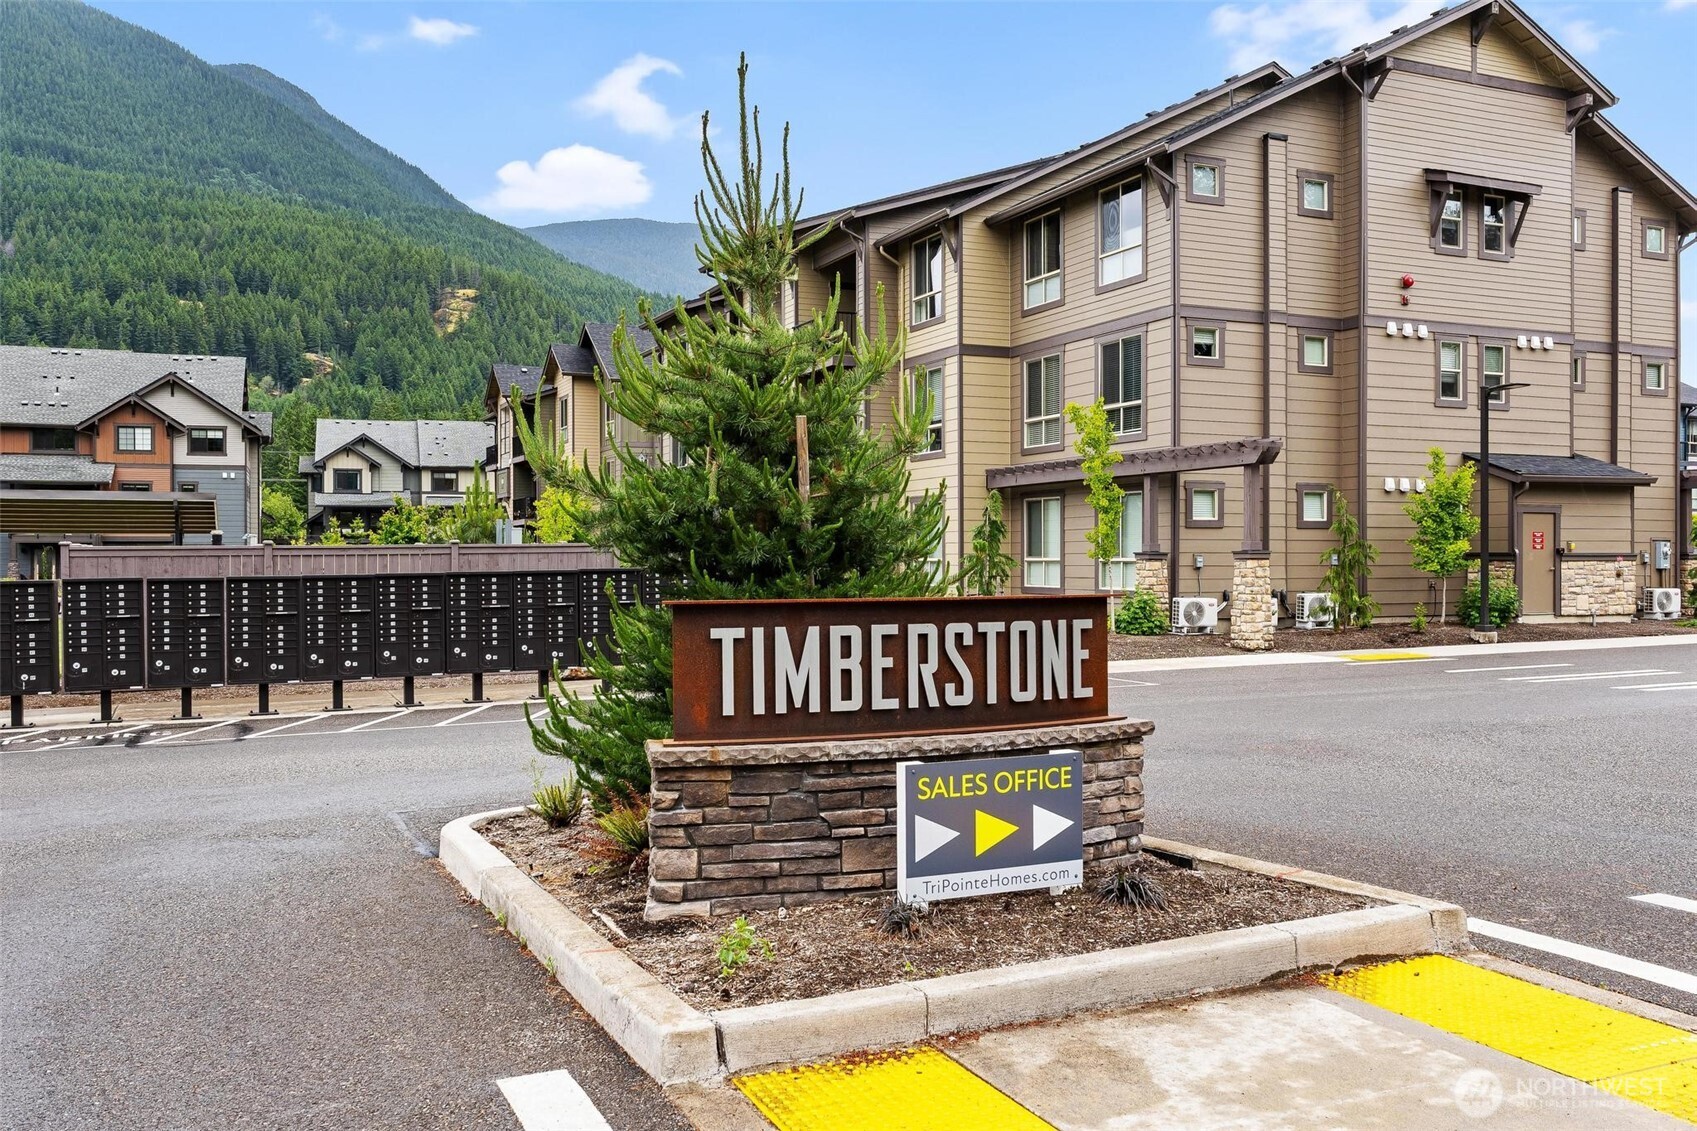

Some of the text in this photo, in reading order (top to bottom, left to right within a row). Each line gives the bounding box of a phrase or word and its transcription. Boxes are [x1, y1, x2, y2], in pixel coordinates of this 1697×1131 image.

[710, 619, 1093, 716] TIMBERSTONE
[917, 766, 1072, 800] SALES OFFICE
[923, 869, 1070, 895] TriPointeHomes.com
